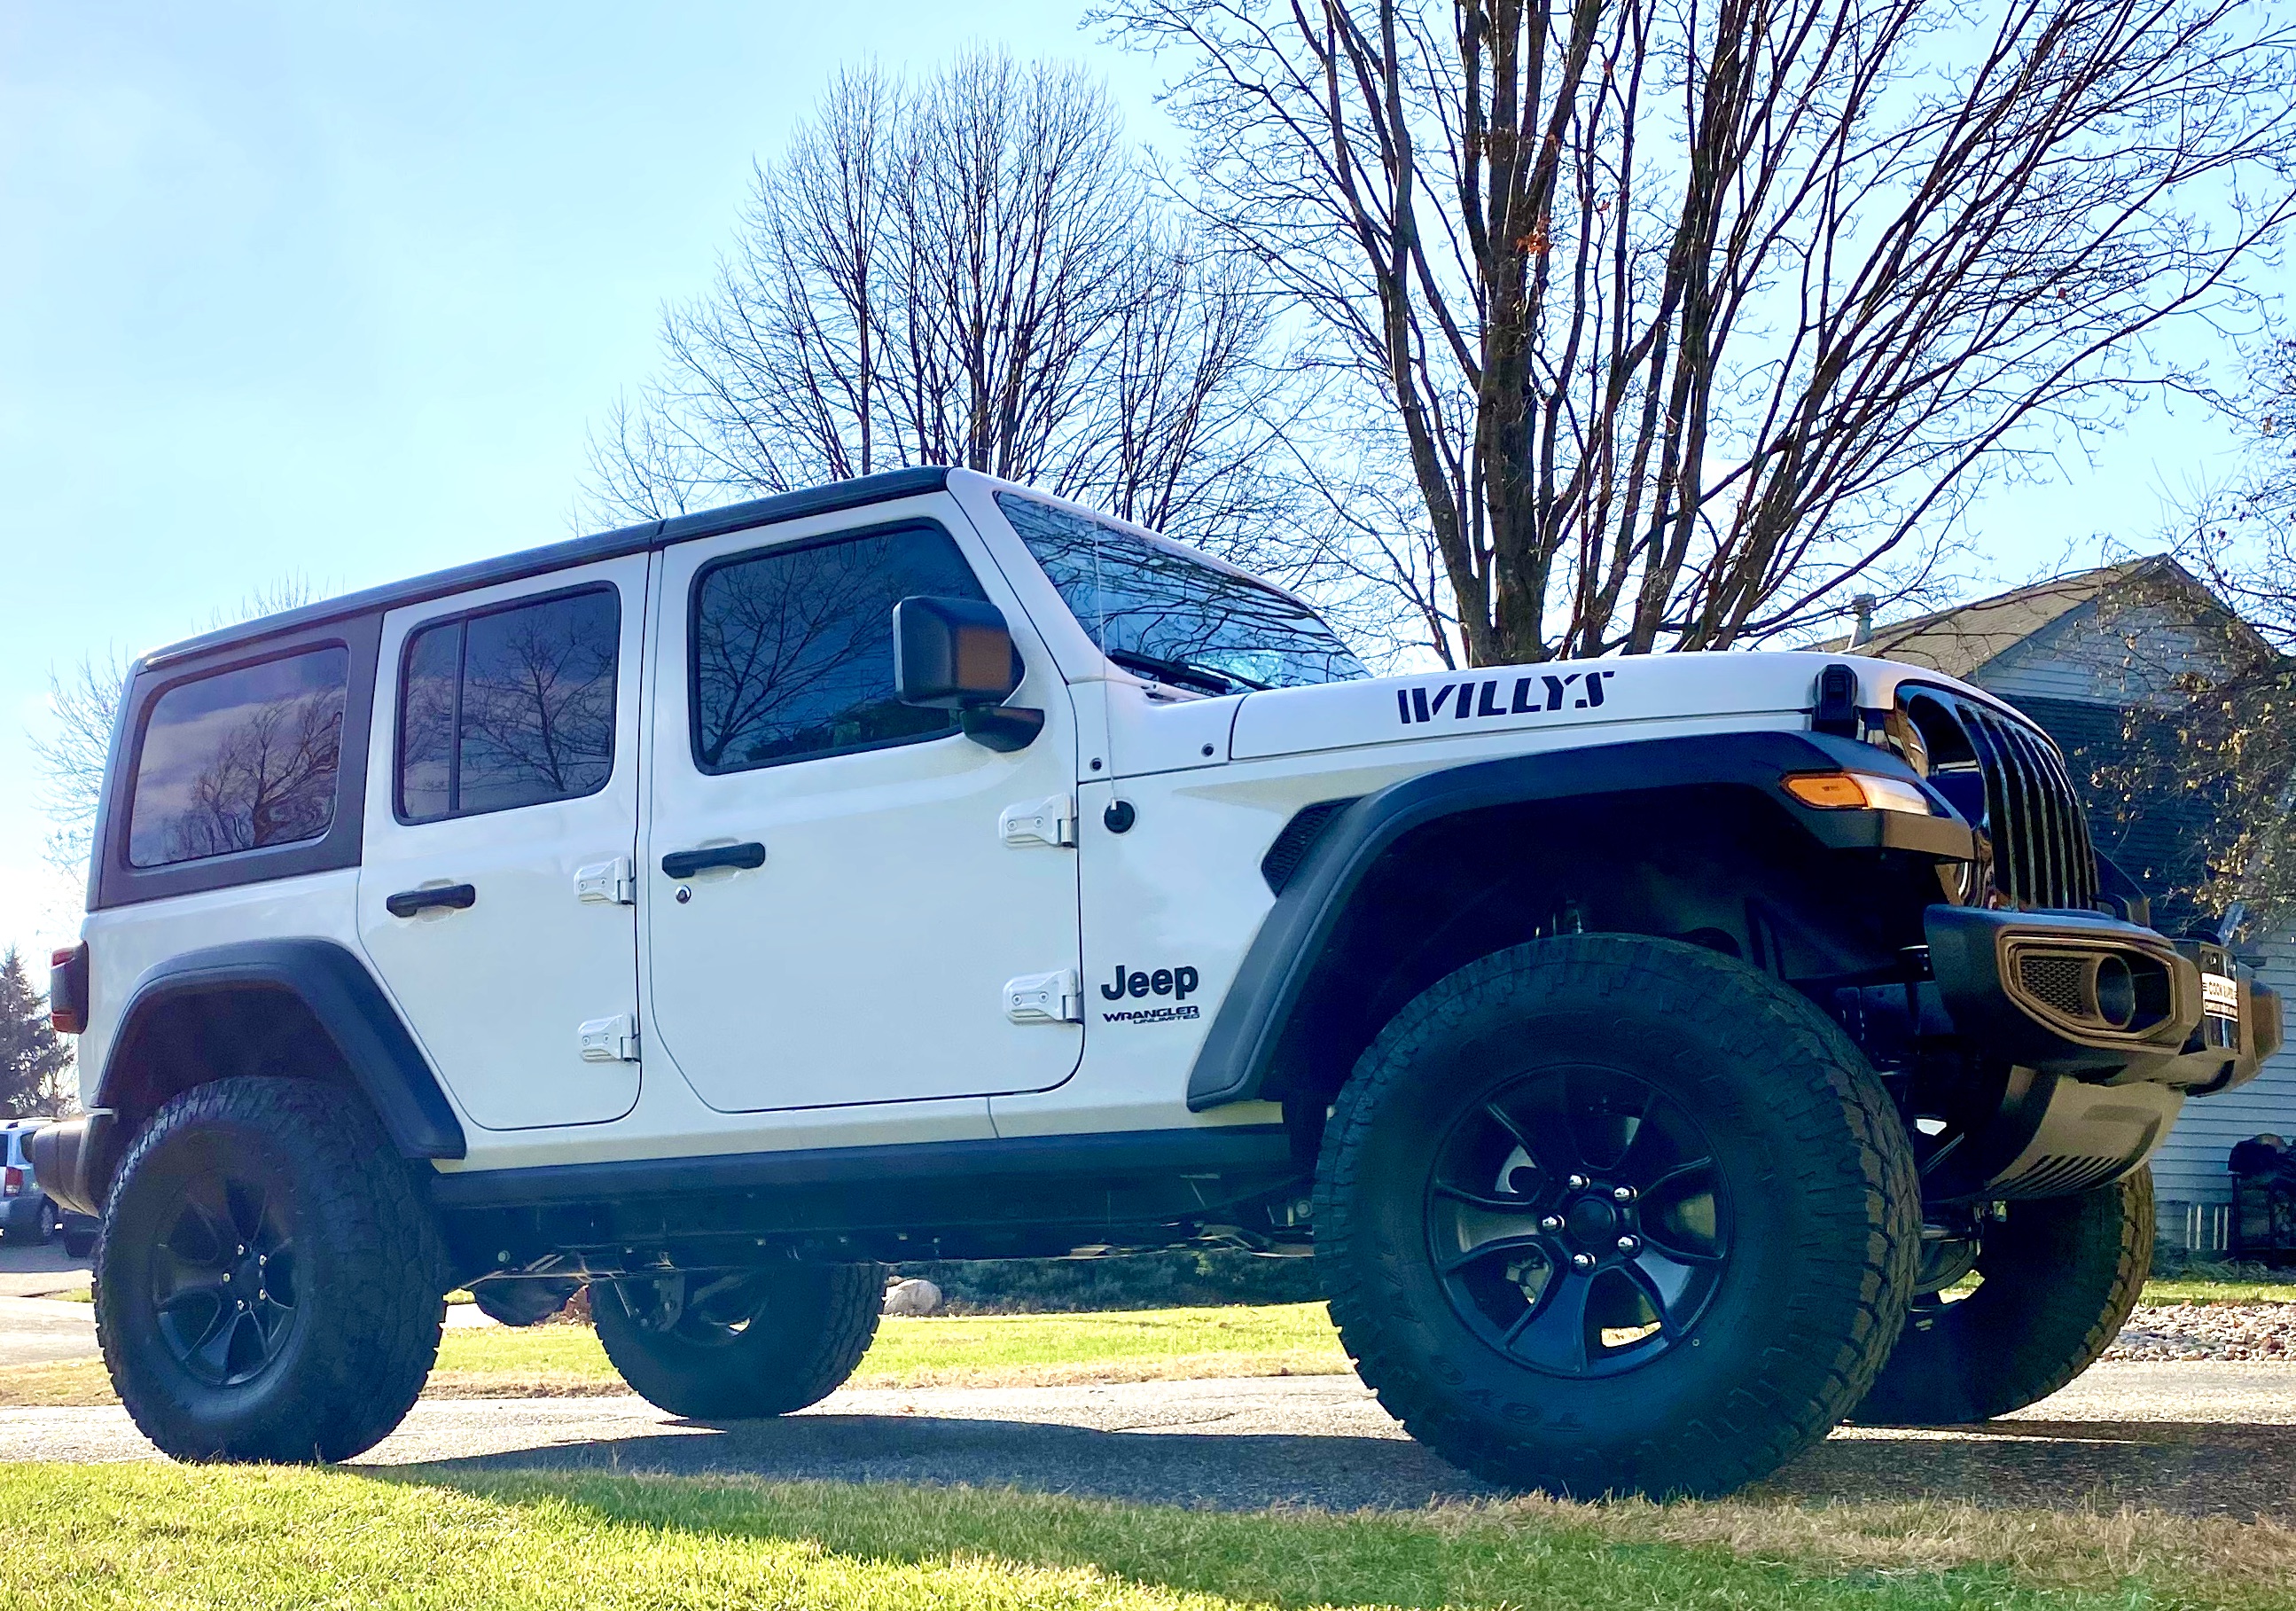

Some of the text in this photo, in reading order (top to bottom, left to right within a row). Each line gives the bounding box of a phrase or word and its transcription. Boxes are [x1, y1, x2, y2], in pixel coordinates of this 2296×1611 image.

[1397, 670, 1615, 724] WILLYS
[1100, 965, 1199, 1001] Jeep
[1103, 1005, 1199, 1022] WRANGLER
[1133, 1013, 1199, 1023] UNLIMITED
